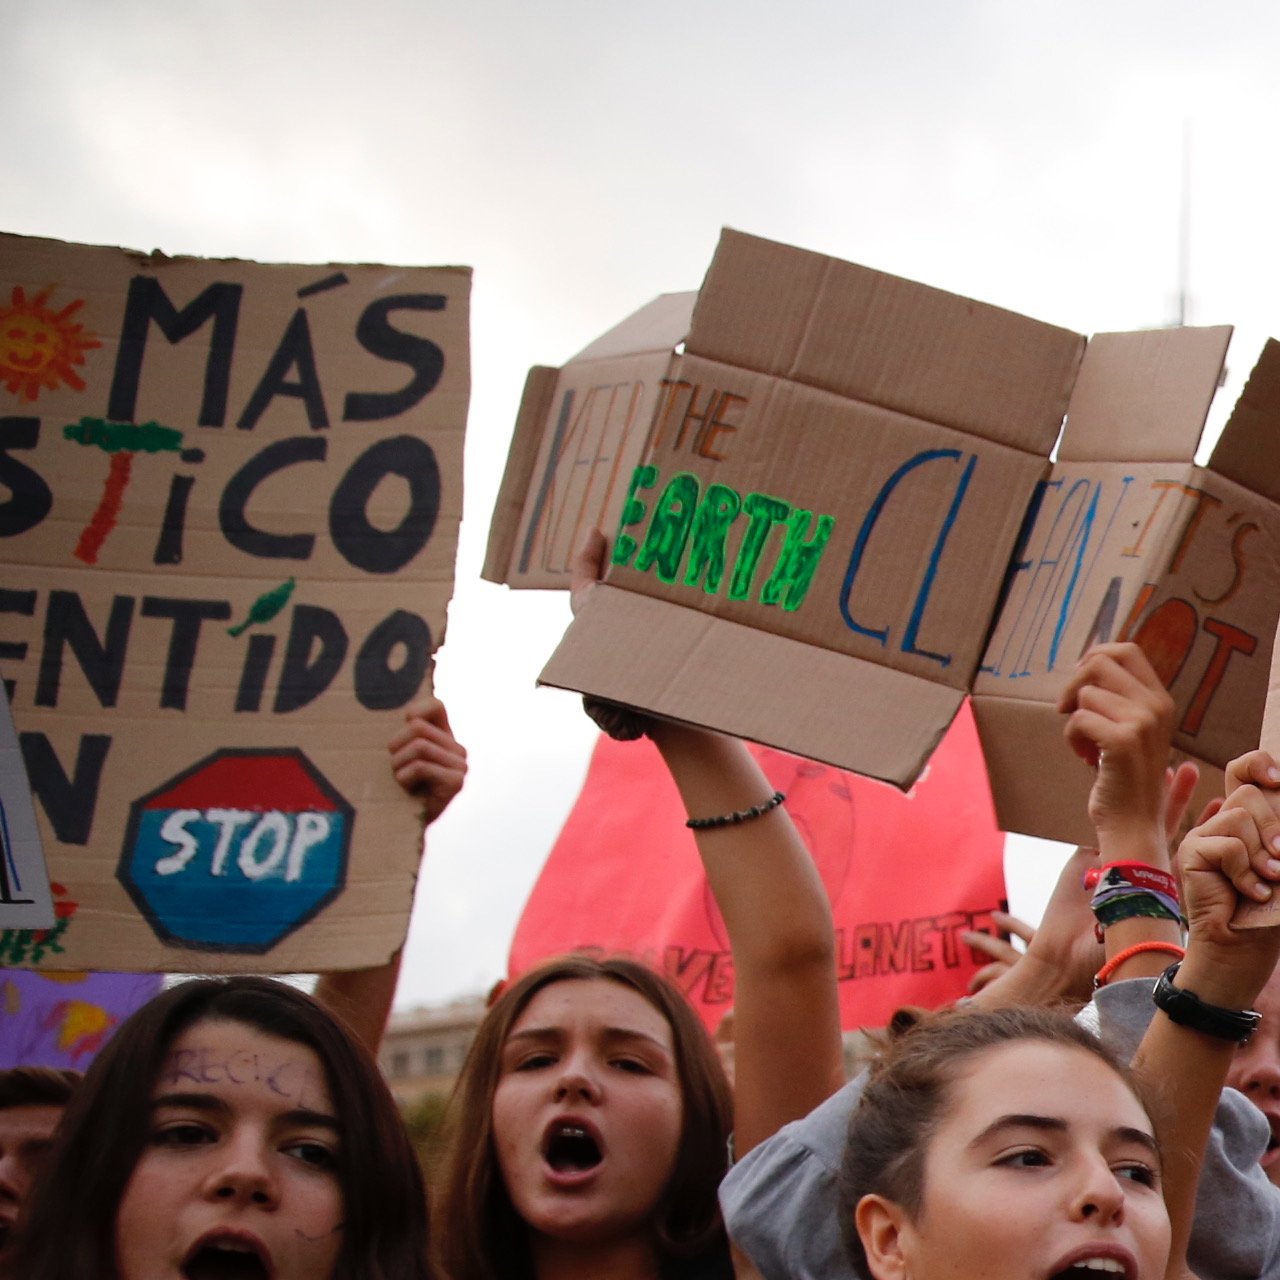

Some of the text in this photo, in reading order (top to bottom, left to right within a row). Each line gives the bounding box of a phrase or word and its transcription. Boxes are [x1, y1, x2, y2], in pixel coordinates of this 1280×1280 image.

[107, 272, 447, 430] MÁS
[657, 379, 749, 462] THE
[611, 447, 1135, 679] EARTH CLEAN
[1121, 478, 1260, 609] IT'S
[155, 804, 332, 882] STOP
